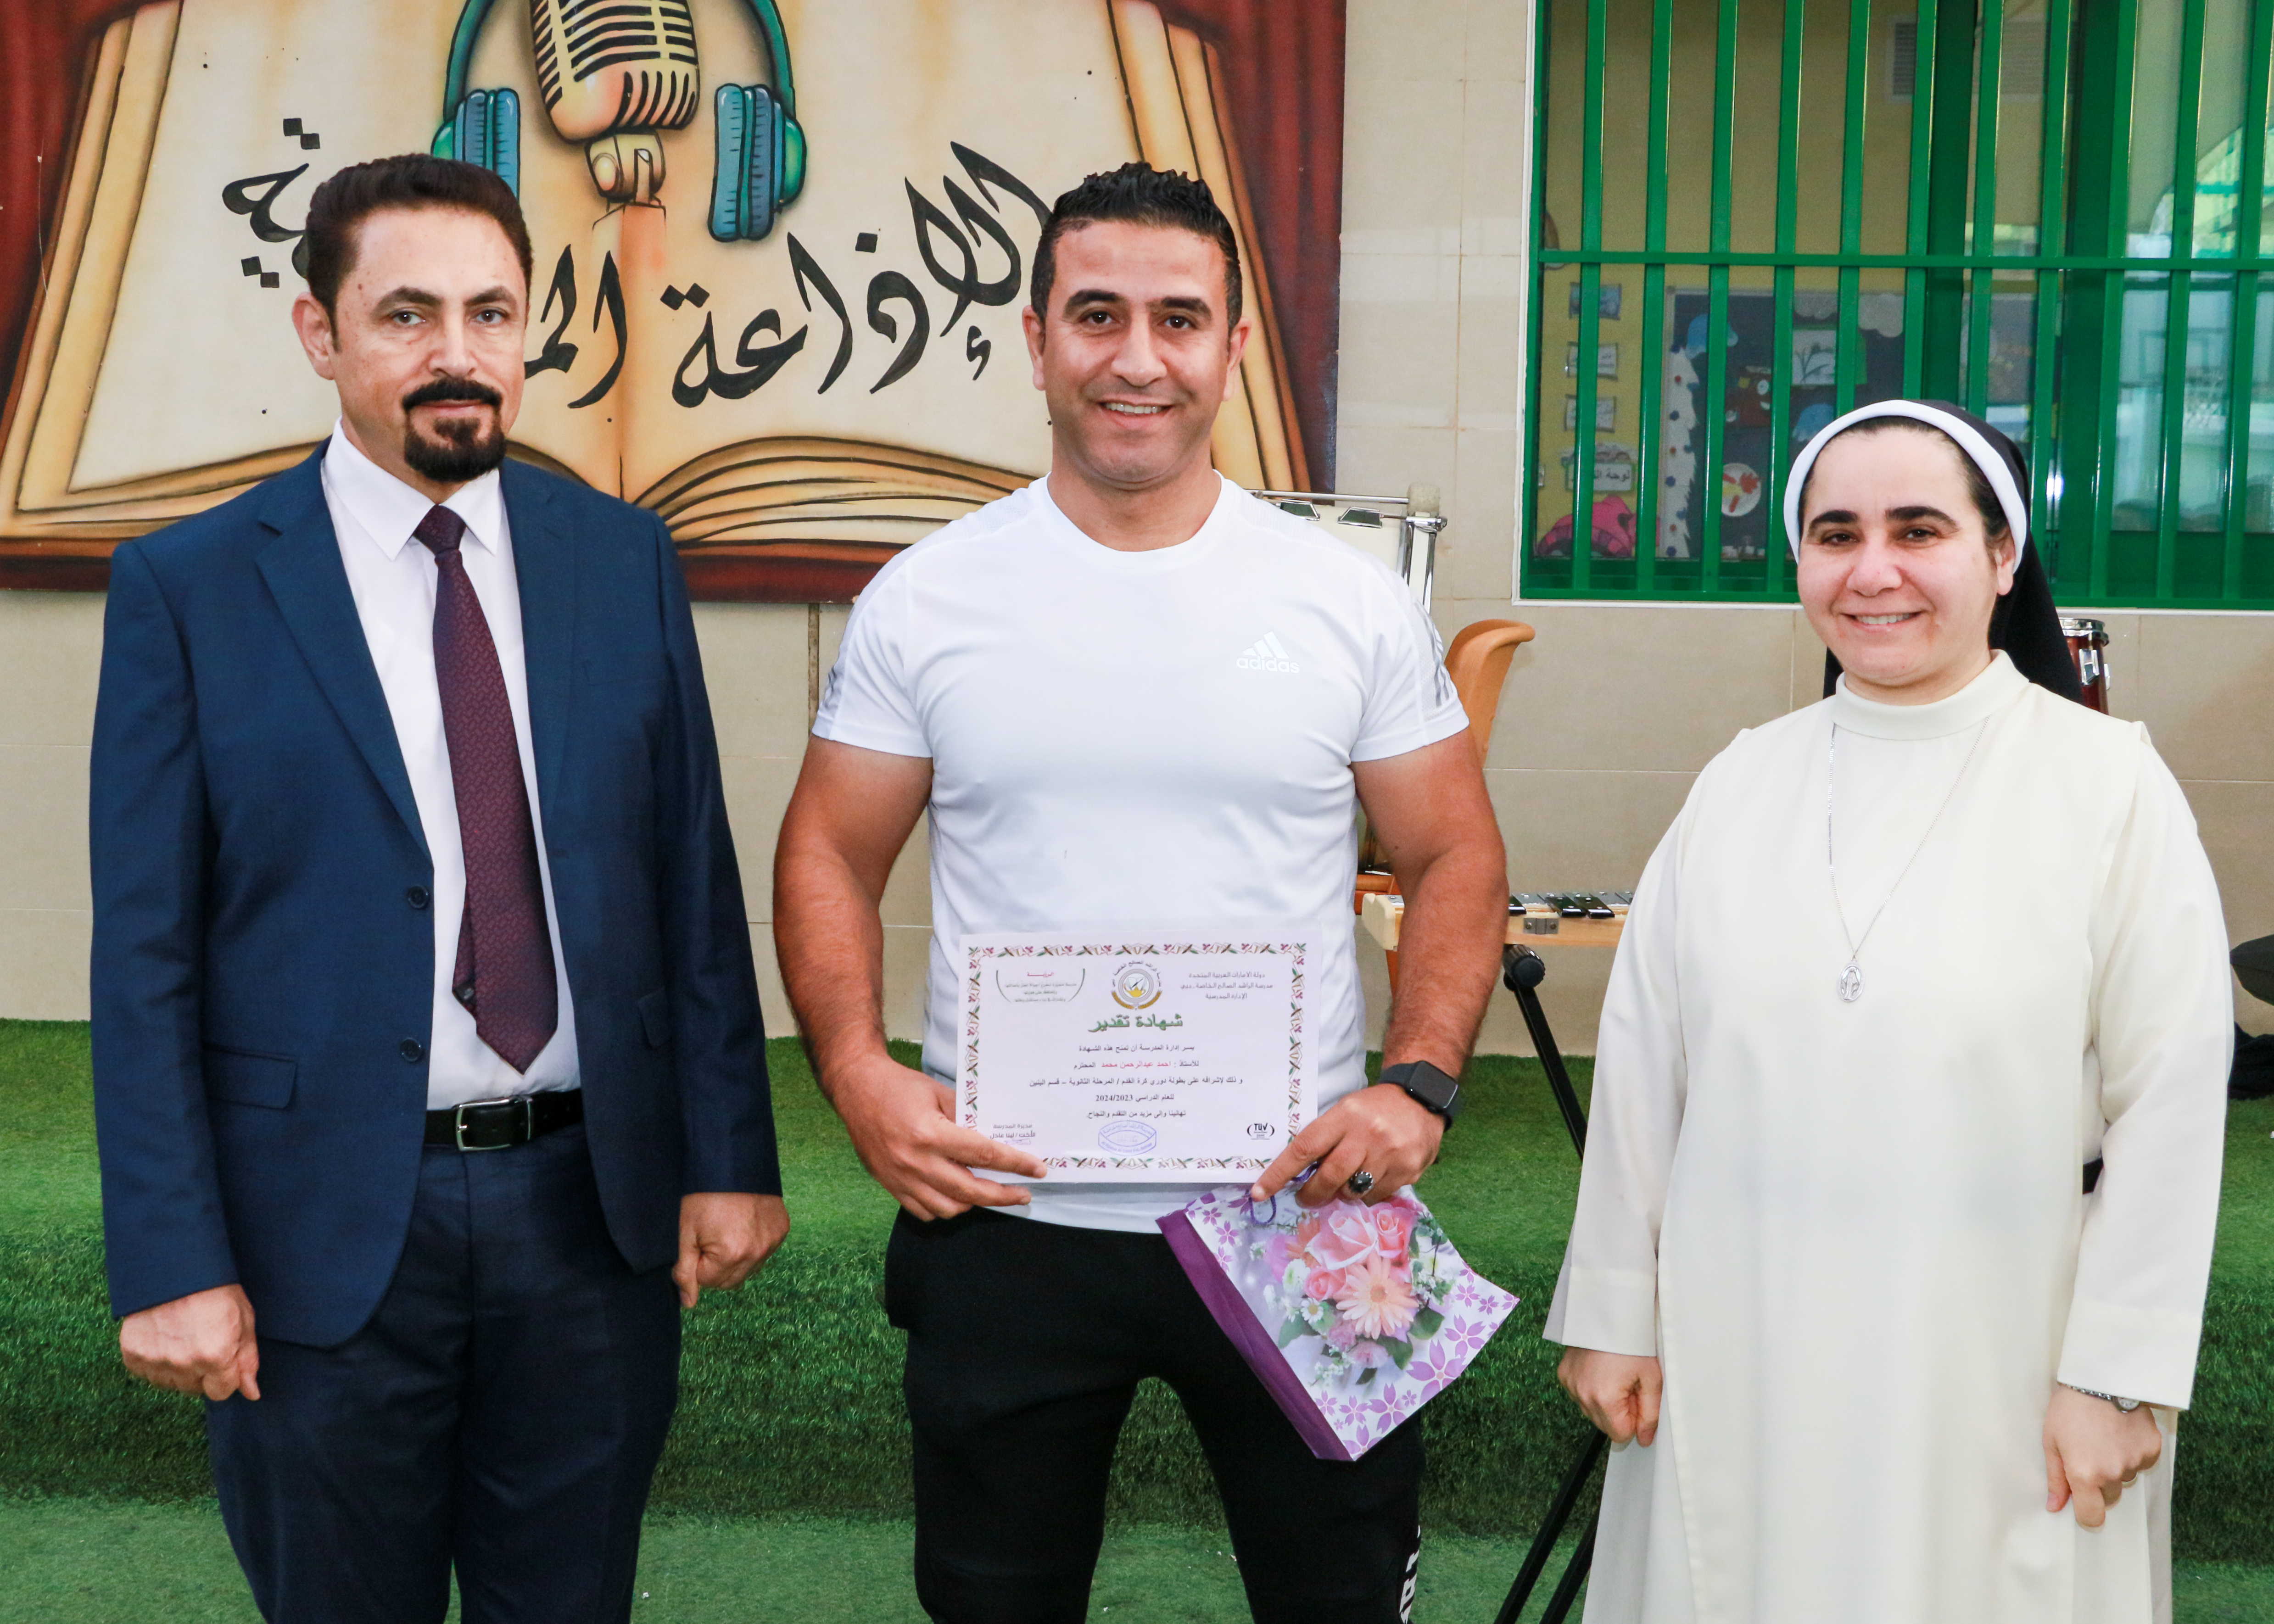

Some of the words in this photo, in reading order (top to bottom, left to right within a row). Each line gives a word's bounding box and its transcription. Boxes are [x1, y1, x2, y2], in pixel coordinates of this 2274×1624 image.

[1236, 656, 1300, 673] adidas
[1088, 1014, 1130, 1032] تقدير
[1135, 1013, 1183, 1031] شهادة
[1048, 1077, 1059, 1087] قسم
[1069, 1077, 1090, 1086] الثانوية
[1093, 1077, 1114, 1085] المرحلة
[1122, 1077, 1134, 1086] القدم
[1187, 1077, 1199, 1085] على
[1136, 1094, 1159, 1102] الدراسي
